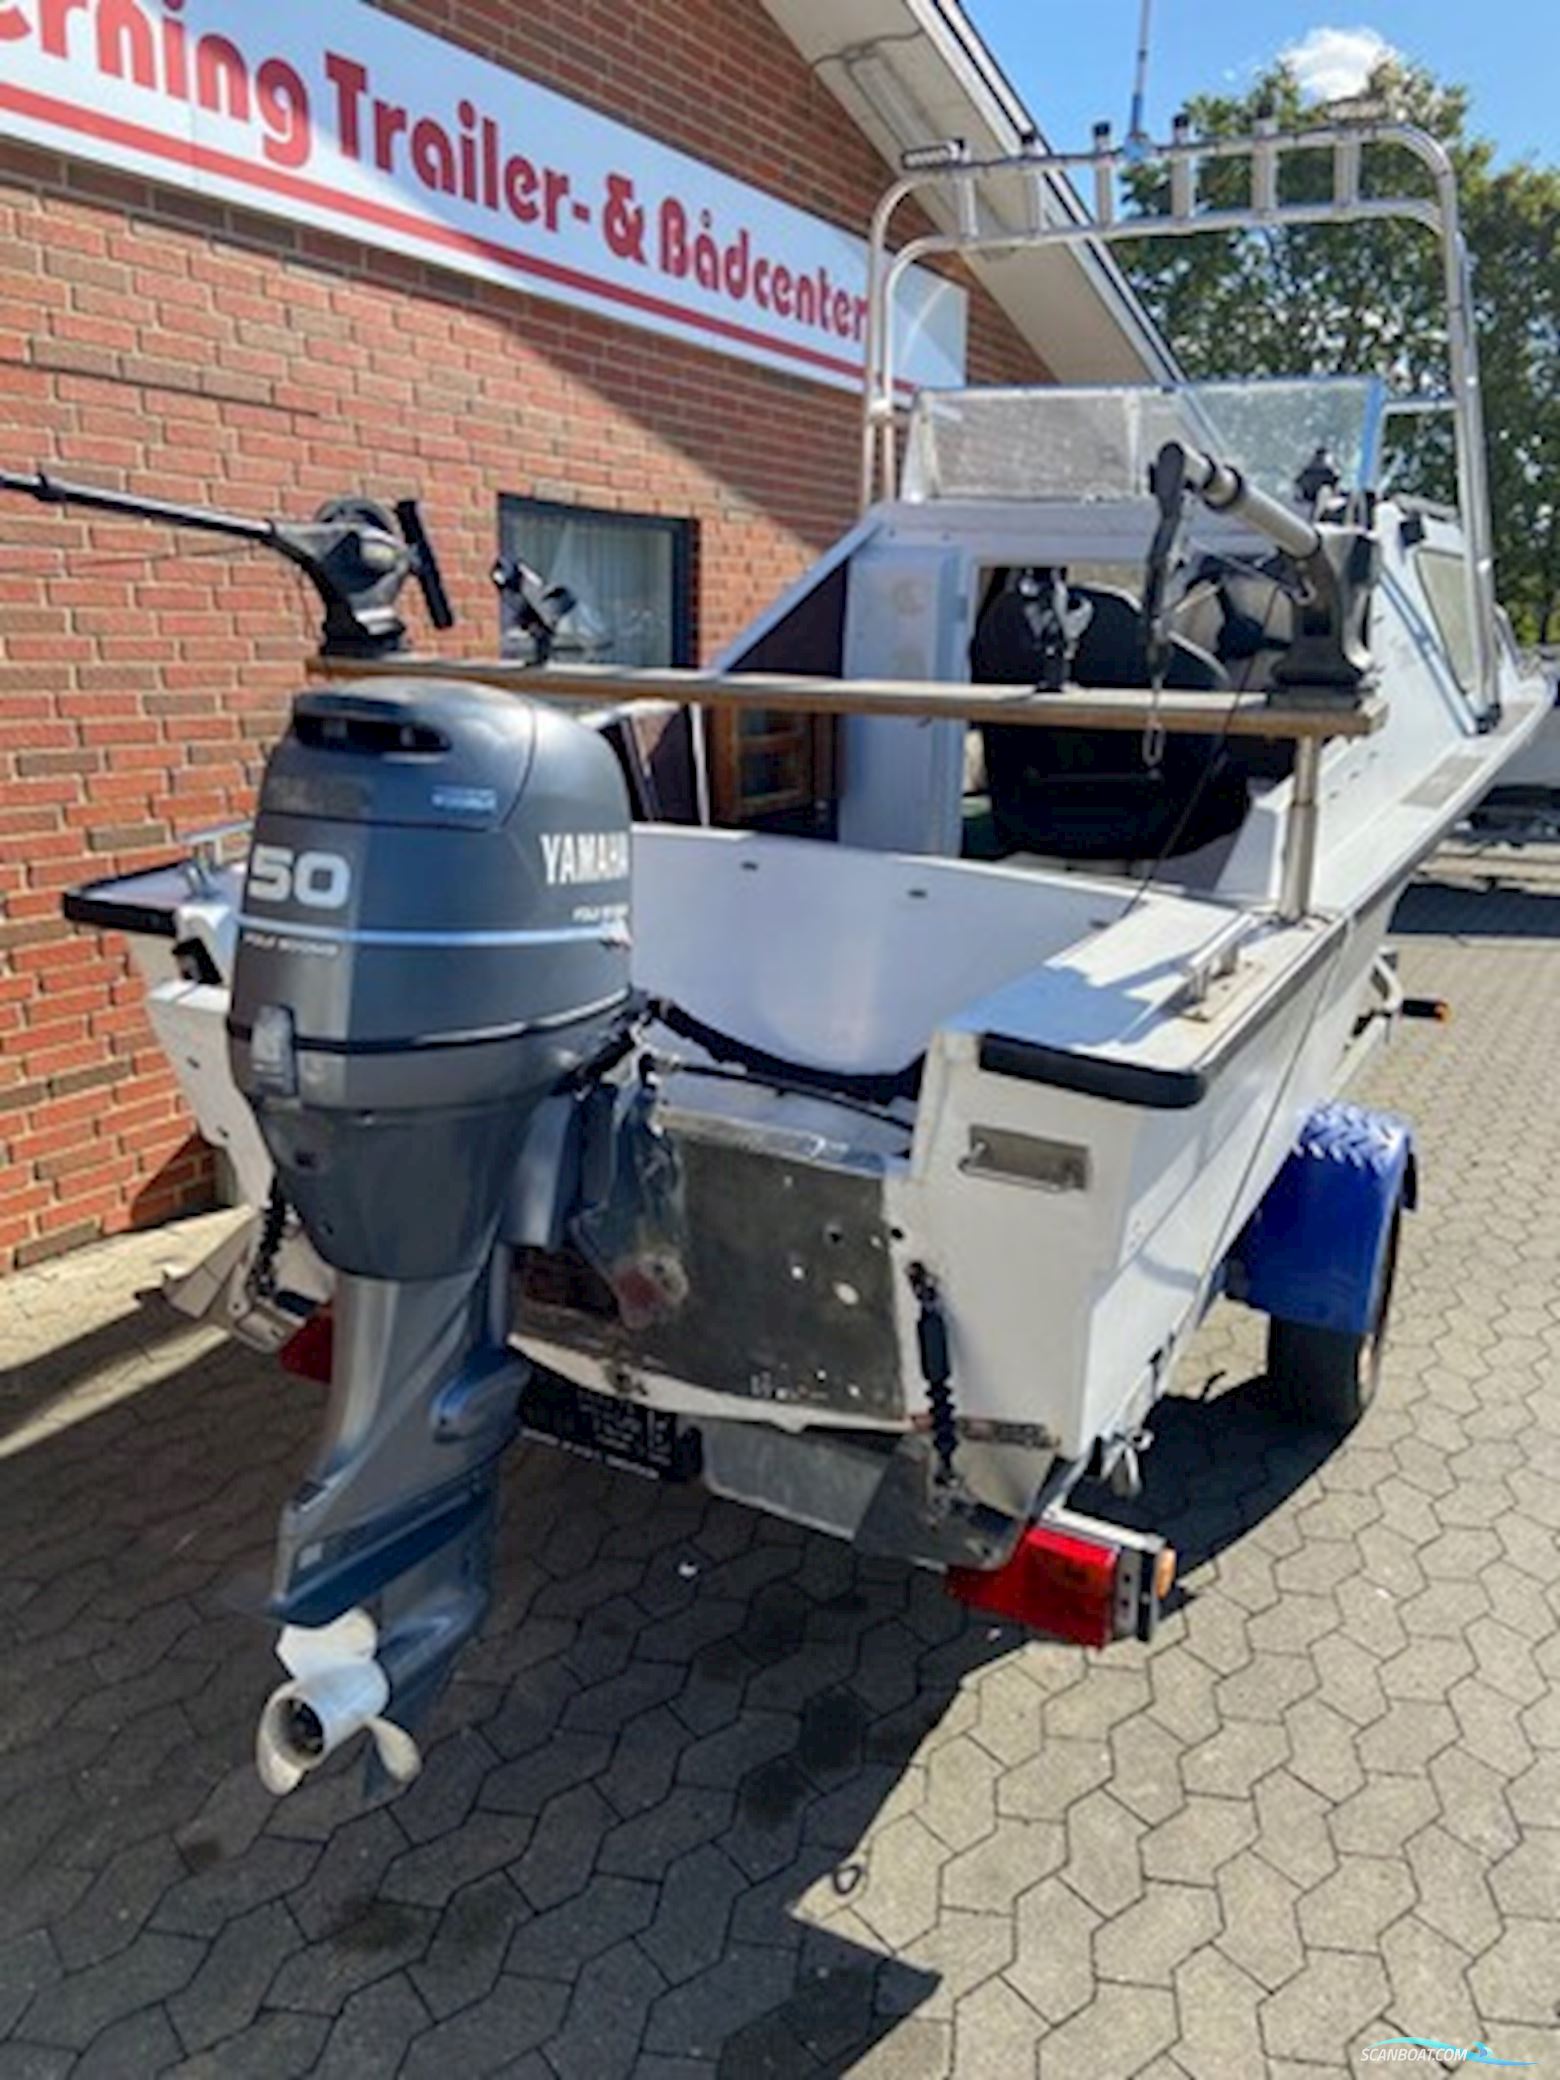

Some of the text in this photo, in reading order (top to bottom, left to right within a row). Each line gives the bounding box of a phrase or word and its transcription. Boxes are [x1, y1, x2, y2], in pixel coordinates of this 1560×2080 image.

[325, 50, 591, 232] Trailer-
[604, 173, 647, 266] &
[660, 197, 868, 341] Bådcenter
[247, 844, 351, 909] 50
